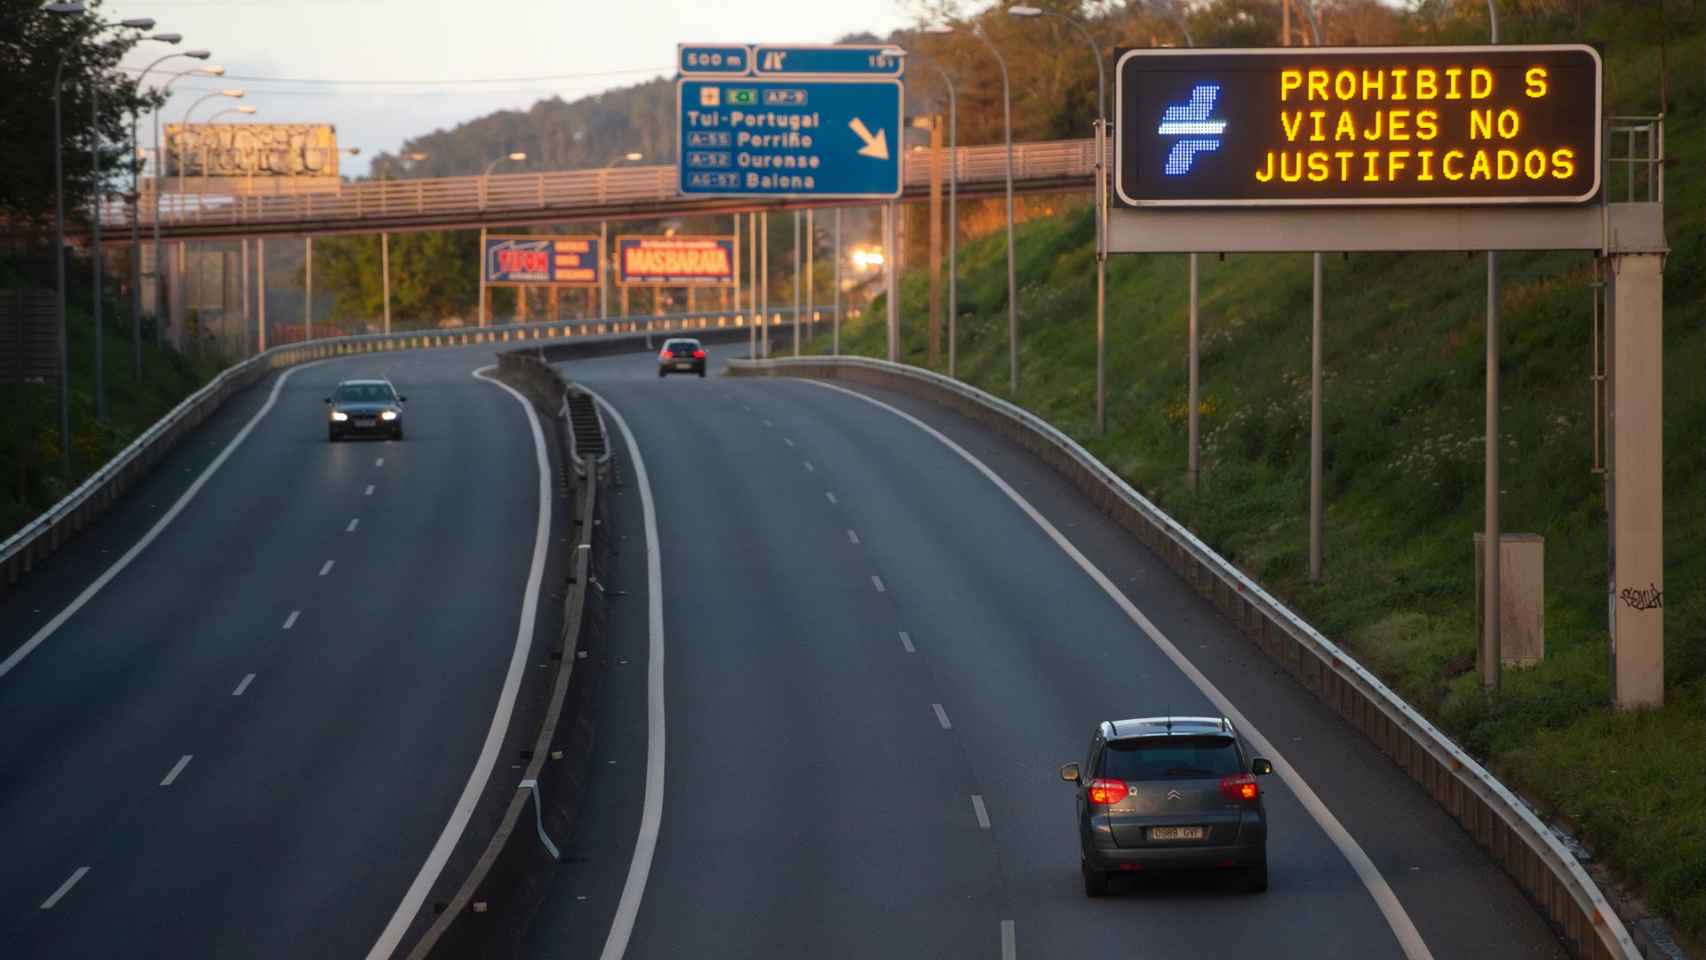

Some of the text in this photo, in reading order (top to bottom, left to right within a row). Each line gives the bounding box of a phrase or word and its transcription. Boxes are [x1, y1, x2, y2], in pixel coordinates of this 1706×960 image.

[688, 54, 741, 66] 500 m
[1281, 68, 1549, 101] PROHIBID S
[1281, 109, 1520, 141] VIAJES NO
[737, 152, 820, 167] Ourense
[1255, 149, 1575, 182] JUSTIFICADOS
